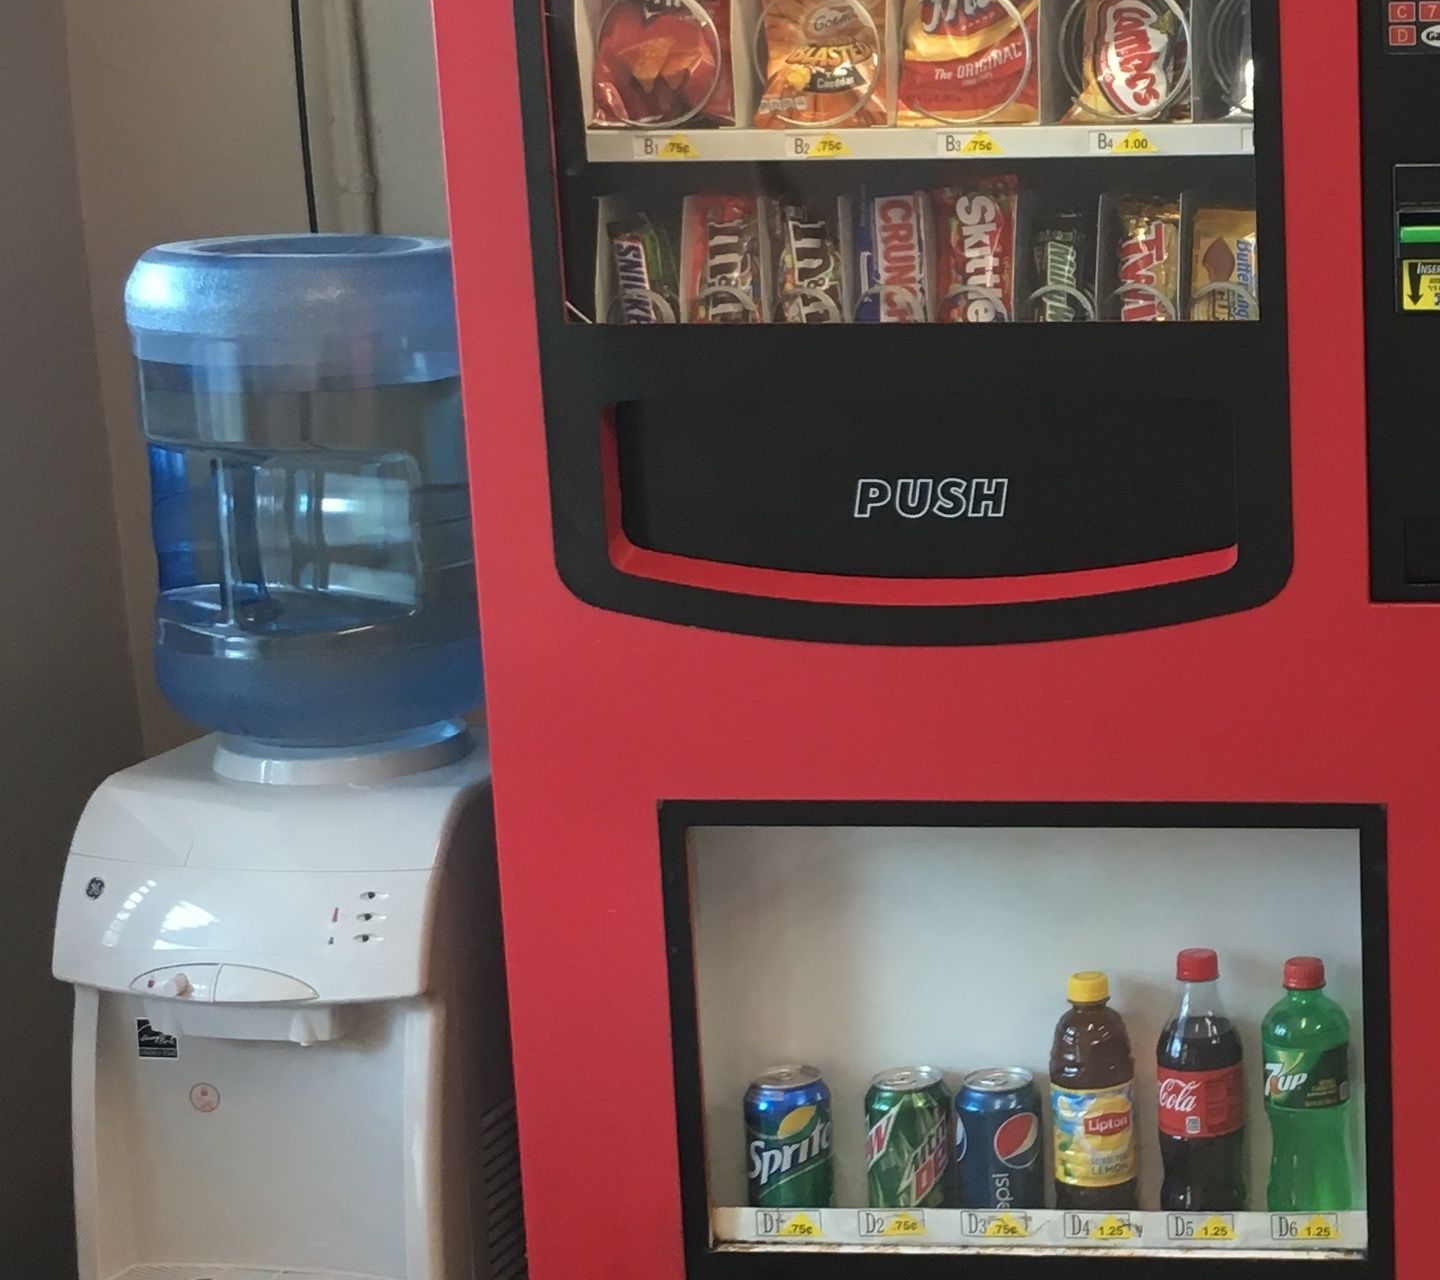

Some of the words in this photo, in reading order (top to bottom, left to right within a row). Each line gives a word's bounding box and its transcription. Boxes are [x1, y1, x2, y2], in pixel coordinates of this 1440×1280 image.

[1397, 6, 1408, 18] C
[1428, 5, 1437, 18] 7
[1397, 30, 1408, 42] D
[786, 42, 873, 68] BLASTED
[934, 67, 953, 80] The
[956, 42, 1023, 80] ORIGINAL
[794, 138, 809, 154] B2
[945, 135, 961, 152] B3
[1098, 133, 1113, 150] B4
[1123, 138, 1148, 151] 1.00
[854, 478, 1008, 518] PUSH
[1088, 1116, 1128, 1133] Lipton
[865, 1212, 885, 1233] D2
[968, 1213, 987, 1233] D3
[1071, 1216, 1090, 1236] D4
[1099, 1225, 1124, 1236] 1.25
[1175, 1216, 1194, 1237] D5
[1202, 1226, 1228, 1237] 1.25
[1278, 1217, 1298, 1237] D6
[1305, 1226, 1331, 1237] 1.25
